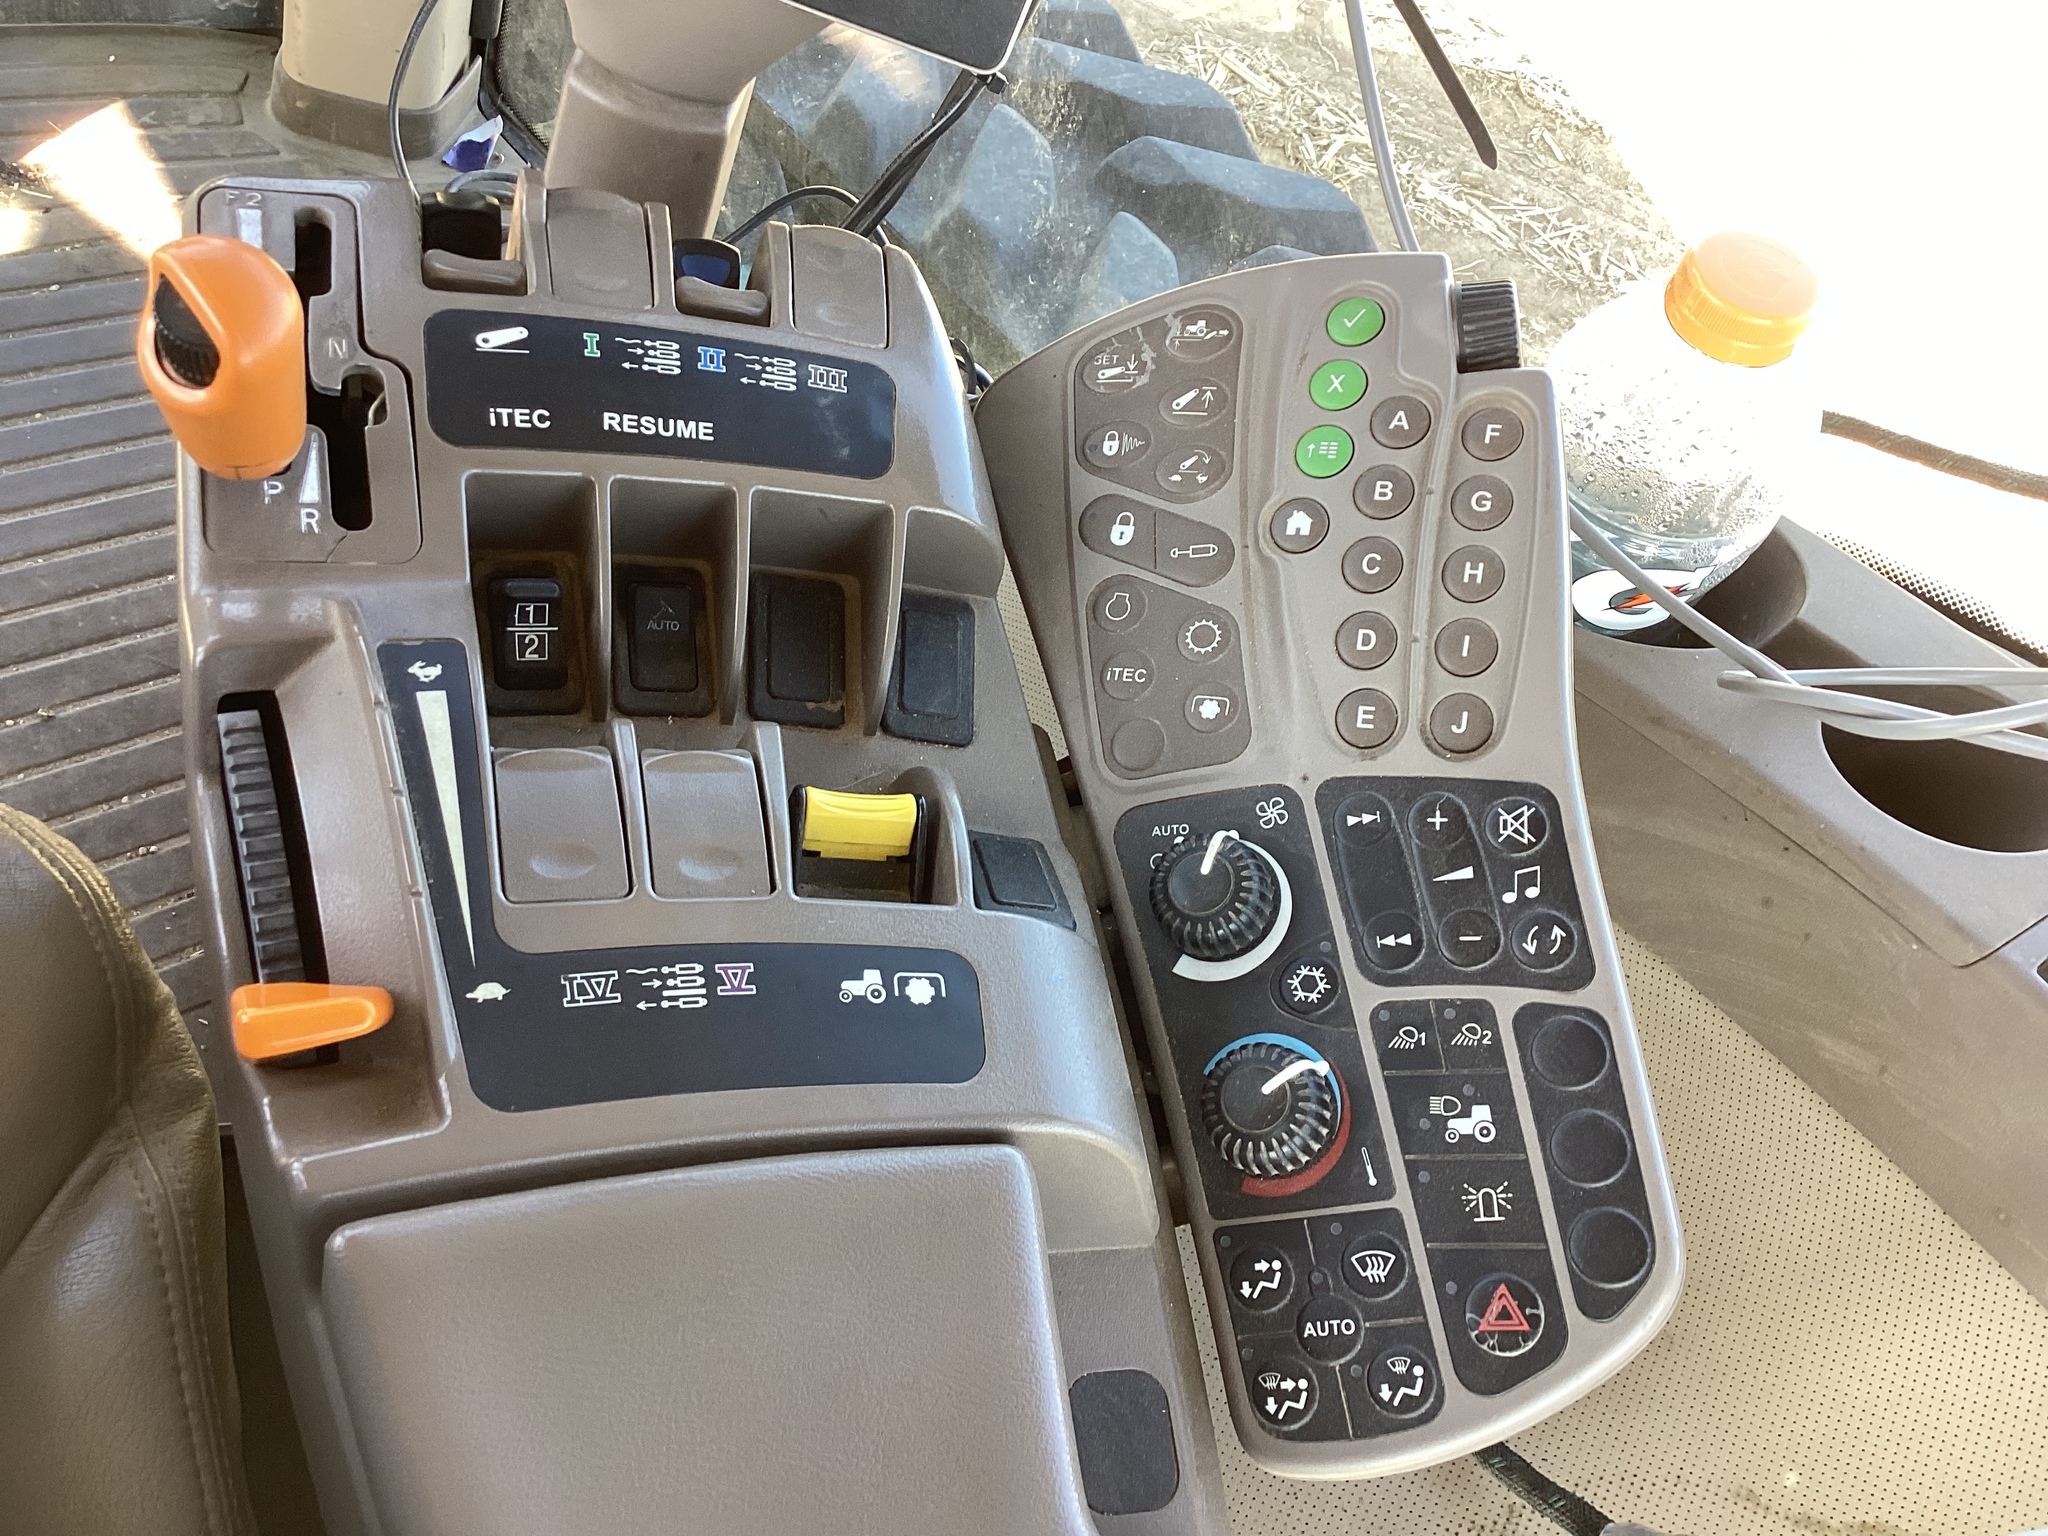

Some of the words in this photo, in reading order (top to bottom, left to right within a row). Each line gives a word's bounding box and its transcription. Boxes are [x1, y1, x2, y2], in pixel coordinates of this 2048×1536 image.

[329, 338, 347, 359] N
[1327, 374, 1345, 393] X
[489, 407, 551, 429] iTEC
[603, 412, 715, 441] RESUME
[1389, 411, 1410, 431] A
[1484, 423, 1502, 444] F
[264, 480, 285, 503] P
[1373, 480, 1394, 501] B
[1470, 490, 1492, 512] G
[300, 508, 320, 533] R
[1361, 553, 1381, 575] C
[1463, 562, 1484, 585] H
[525, 604, 534, 624] 1
[647, 620, 680, 631] AUTO
[524, 634, 539, 659] 2
[1356, 629, 1377, 652] D
[1461, 635, 1470, 657] I
[1106, 666, 1147, 684] iTEC
[1357, 706, 1375, 729] E
[1451, 711, 1468, 735] J
[1152, 824, 1189, 836] AUTO
[1418, 1031, 1426, 1046] 1
[1482, 1030, 1492, 1046] 2
[1303, 1318, 1356, 1338] AUTO
